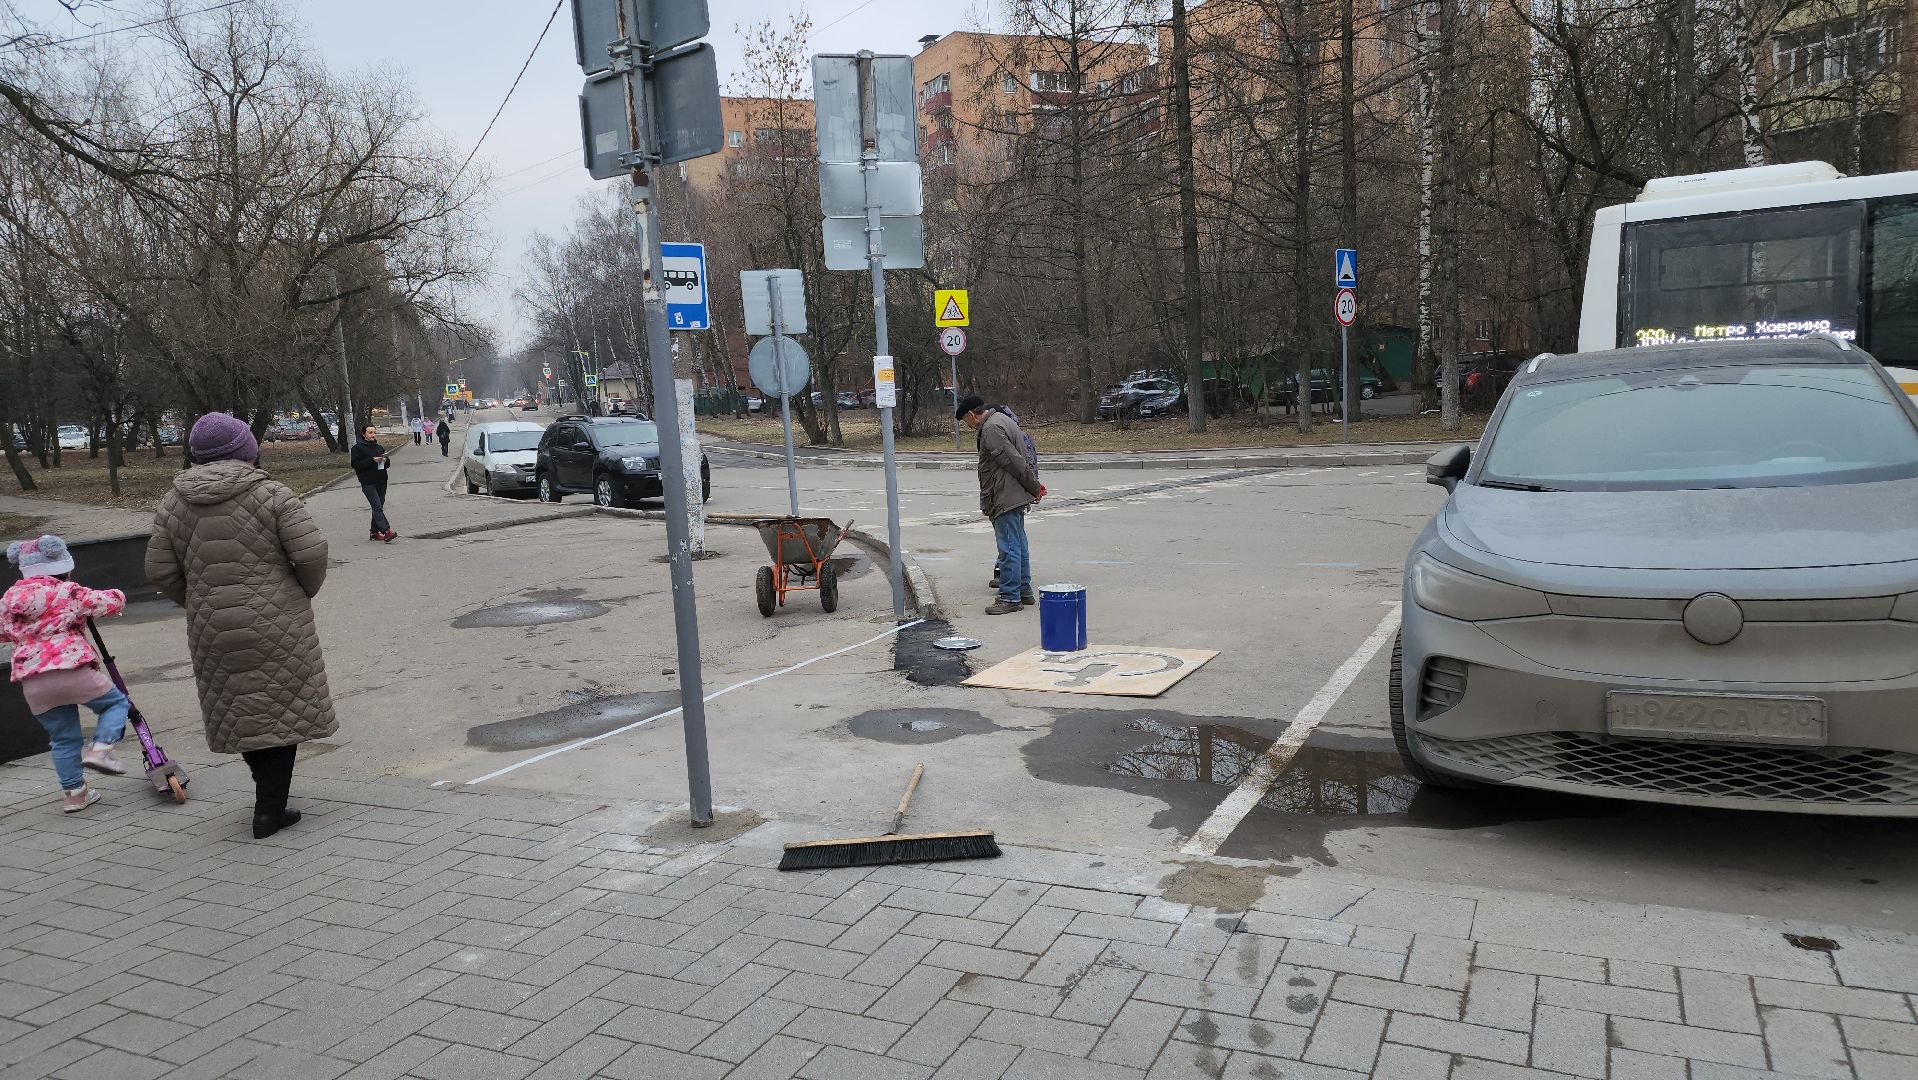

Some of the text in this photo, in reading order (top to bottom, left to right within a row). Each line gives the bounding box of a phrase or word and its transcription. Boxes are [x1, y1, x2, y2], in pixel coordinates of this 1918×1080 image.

[1341, 299, 1354, 315] 20
[1694, 324, 1747, 337] Метро
[1755, 319, 1831, 334] Ховрино
[946, 334, 961, 347] 20
